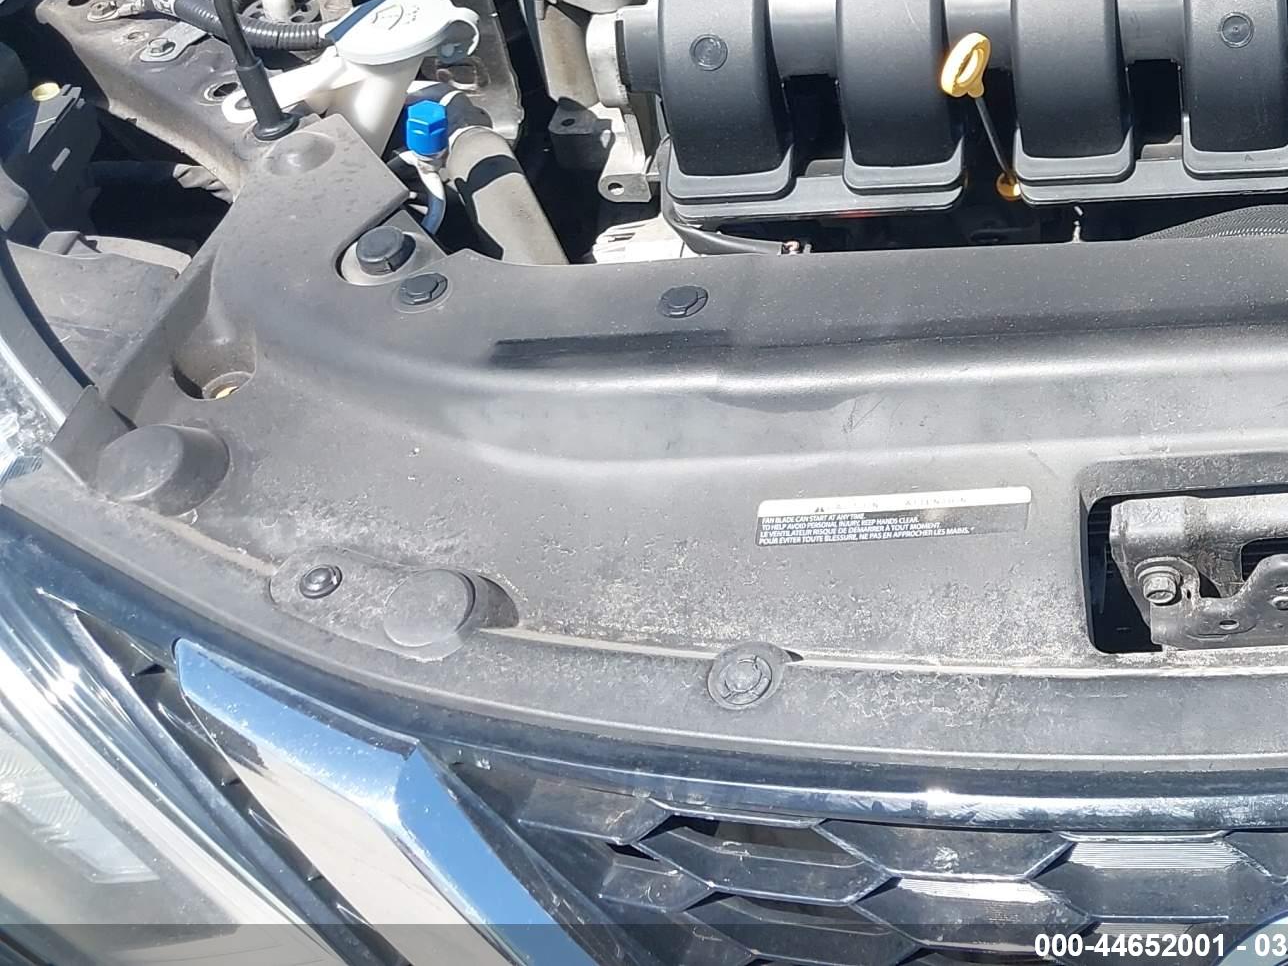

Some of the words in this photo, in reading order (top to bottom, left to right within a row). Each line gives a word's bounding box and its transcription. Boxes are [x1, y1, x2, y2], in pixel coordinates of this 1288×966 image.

[775, 516, 794, 524] BLADE
[795, 515, 809, 523] CAN
[809, 514, 827, 522] START
[836, 513, 850, 521] ANY
[786, 522, 806, 530] AVOID
[807, 521, 837, 529] PERSONAL
[861, 518, 876, 526] KEEP
[877, 517, 898, 525] HANDS
[759, 537, 779, 545] POUR
[779, 536, 802, 544] ÉVITER
[802, 535, 823, 543] TOUTE
[882, 531, 892, 539] EN
[893, 529, 933, 538] APPROCHER
[933, 528, 946, 536] LES
[769, 529, 812, 538] VENTILATEUR
[813, 528, 837, 536] RISQUE
[891, 523, 909, 531] TOUT
